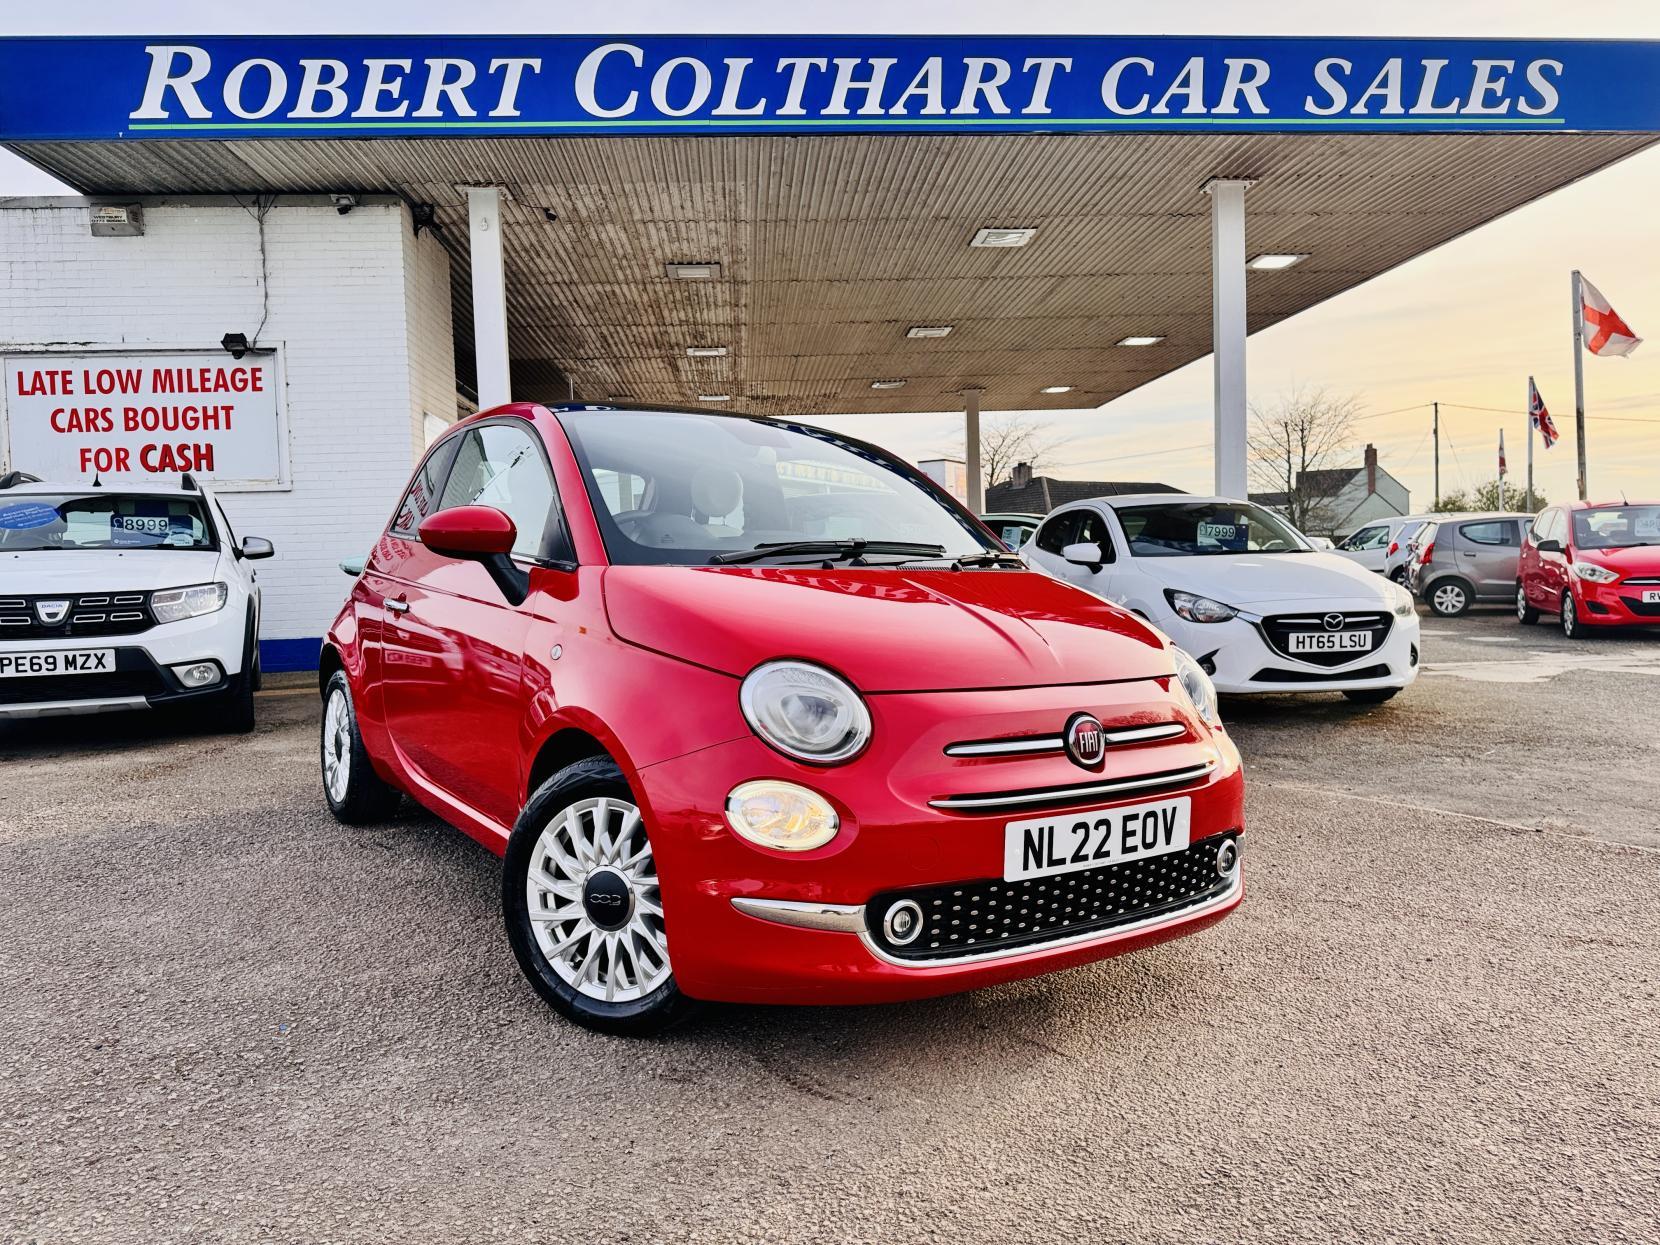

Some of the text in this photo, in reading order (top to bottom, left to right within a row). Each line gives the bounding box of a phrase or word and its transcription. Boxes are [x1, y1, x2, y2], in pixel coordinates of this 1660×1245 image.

[130, 43, 1563, 120] ROBERT COLTHART CAR SALES
[17, 368, 262, 396] LATE LOW MILEAGE
[50, 405, 233, 432] CARS BOUGHT
[80, 443, 214, 473] FOR CASH
[1297, 634, 1366, 649] HT65 LSU
[0, 653, 107, 674] PE69 MZX
[1079, 730, 1098, 752] FIAT
[1022, 806, 1178, 871] NL22 EOV
